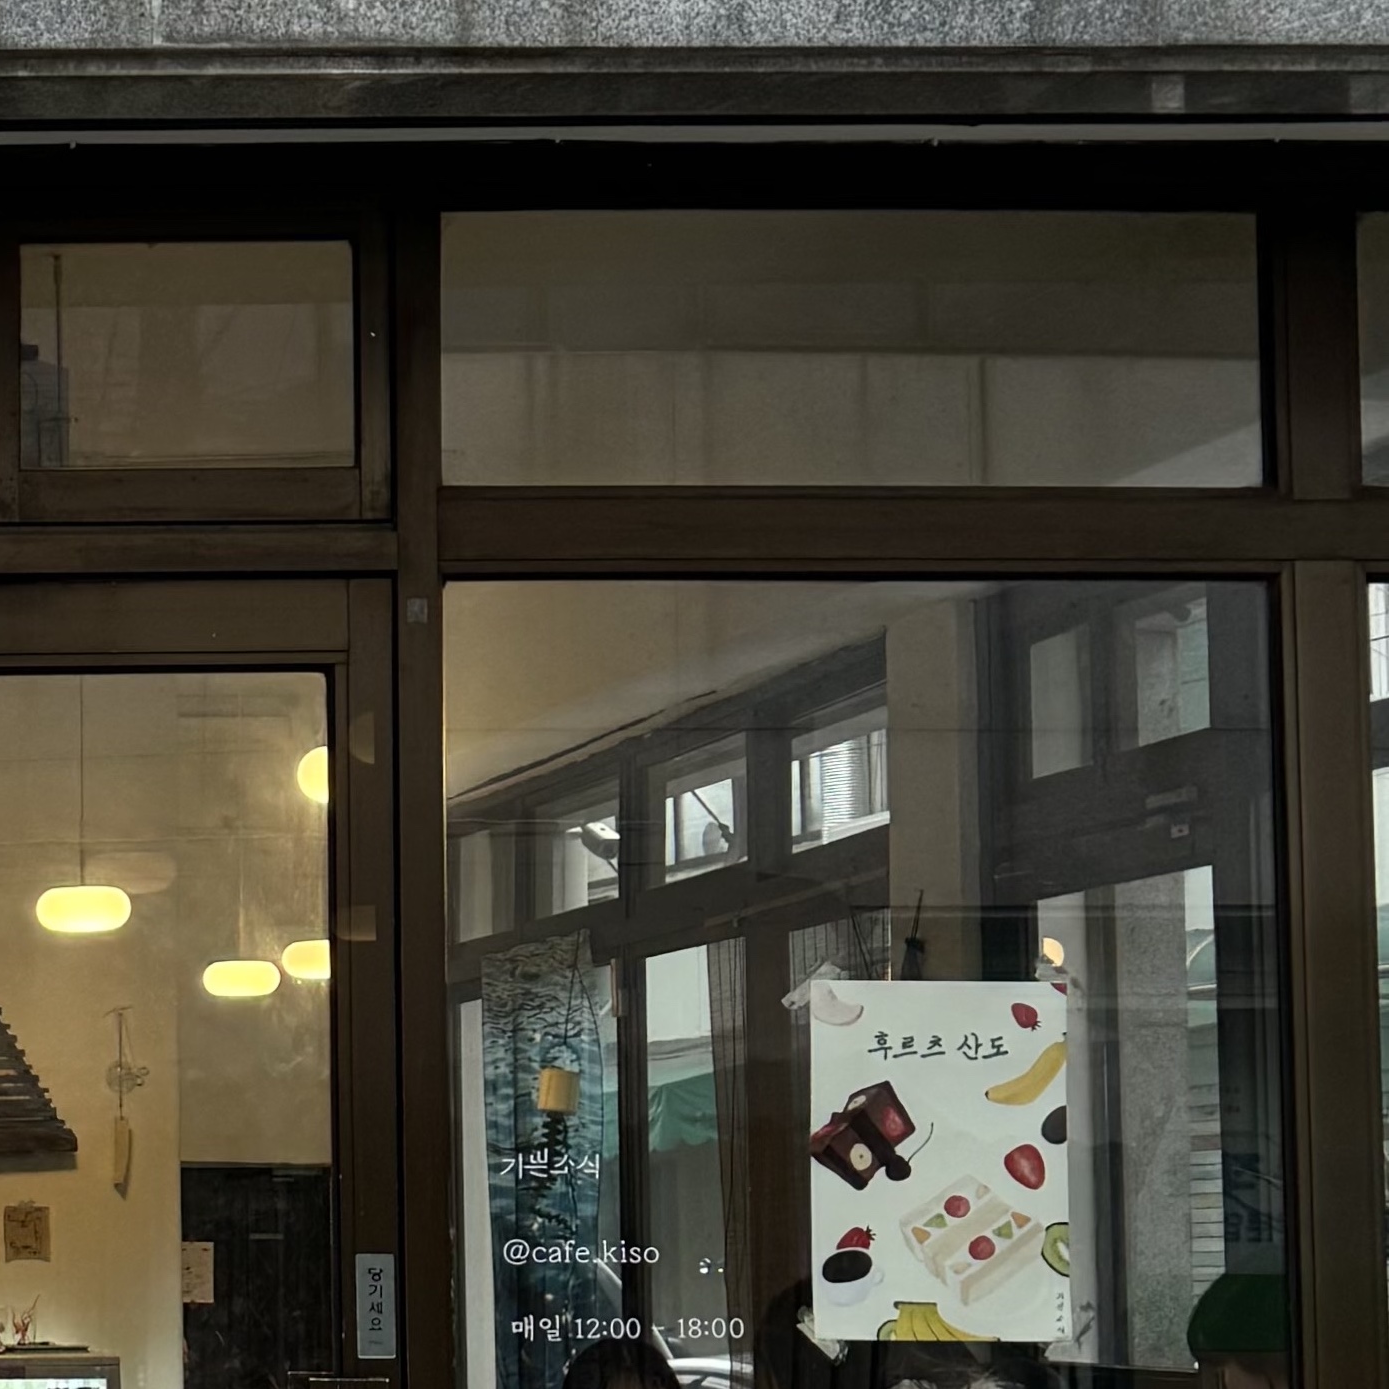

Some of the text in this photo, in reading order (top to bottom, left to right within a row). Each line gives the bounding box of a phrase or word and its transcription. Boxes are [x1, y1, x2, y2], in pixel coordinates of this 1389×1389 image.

[867, 1030, 1009, 1061] 후르츠 산도
[500, 1148, 600, 1179] 기쁜소식
[502, 1239, 660, 1265] @cafe.kiso
[367, 1267, 384, 1331] 당기세요
[511, 1314, 562, 1342] 매일
[575, 1317, 641, 1339] 12:00
[677, 1317, 745, 1339] 18:00
